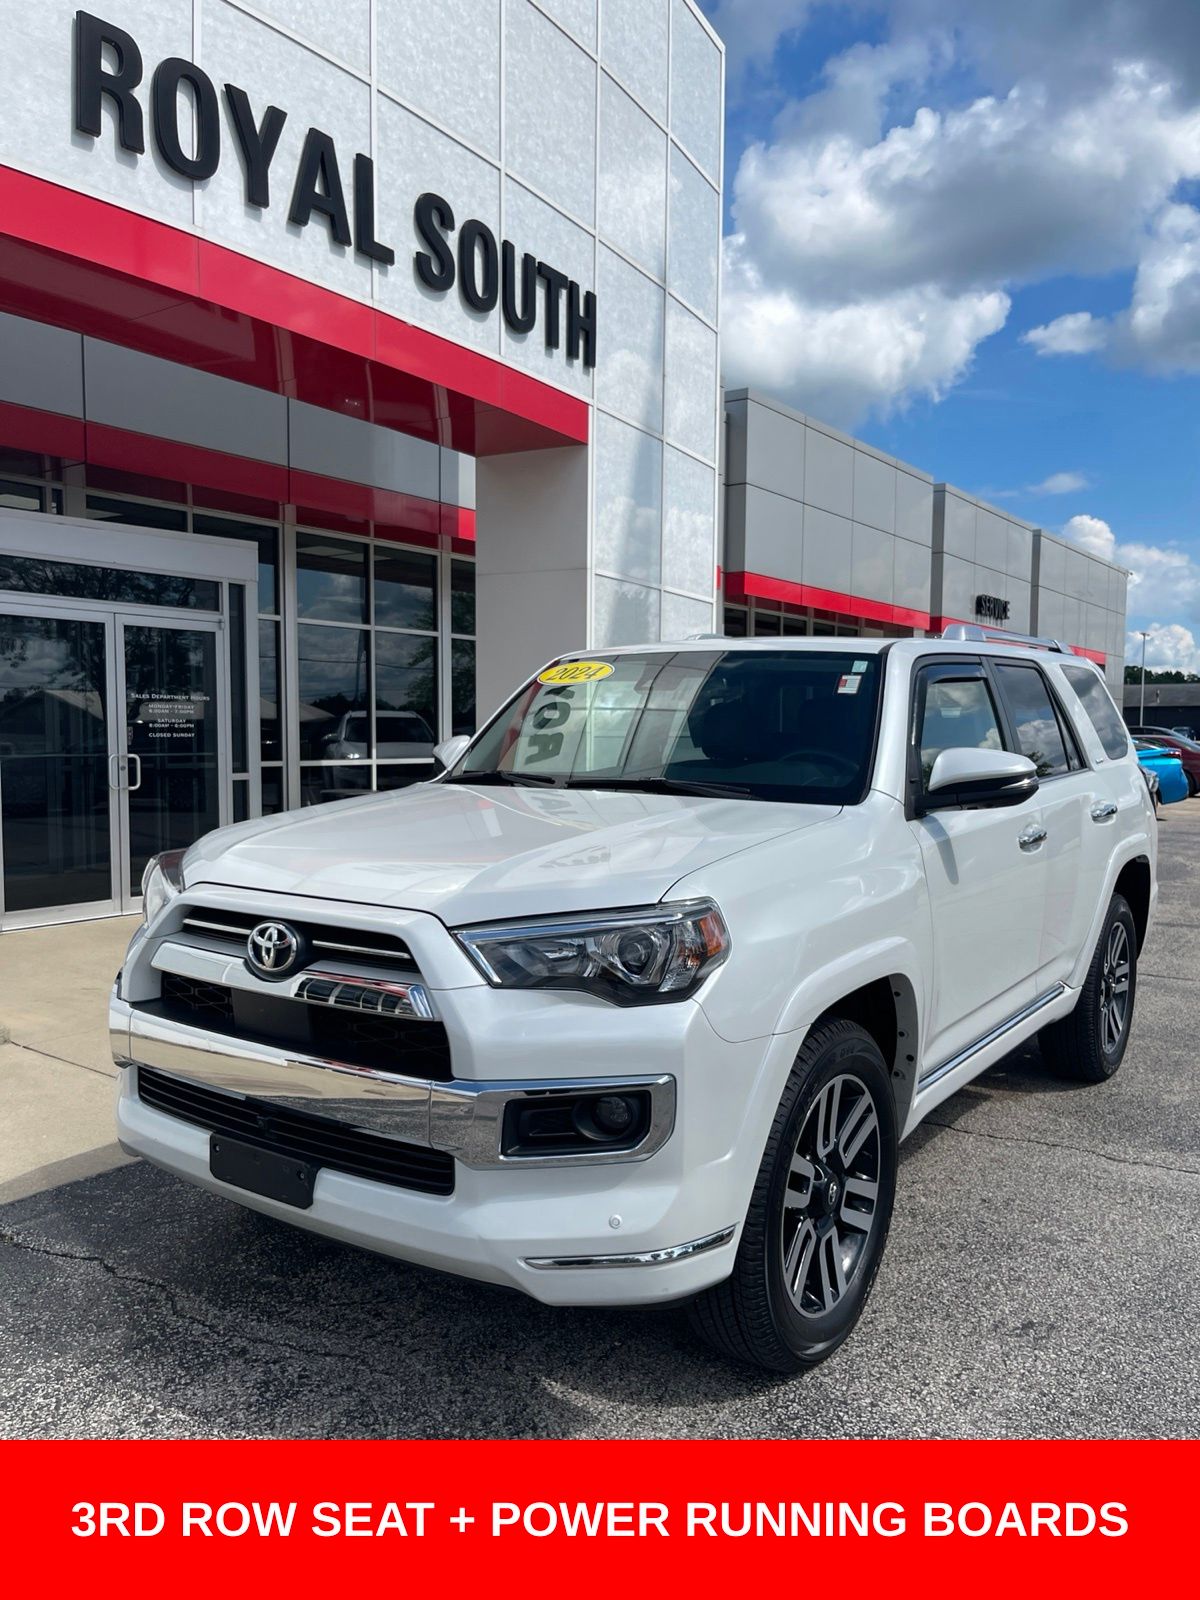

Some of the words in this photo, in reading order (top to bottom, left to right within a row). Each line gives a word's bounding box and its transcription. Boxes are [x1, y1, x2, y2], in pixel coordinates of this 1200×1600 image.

[75, 10, 395, 265] ROYAL
[414, 192, 597, 368] SOUTH
[975, 595, 1010, 620] SERVICE
[546, 666, 606, 680] 2024
